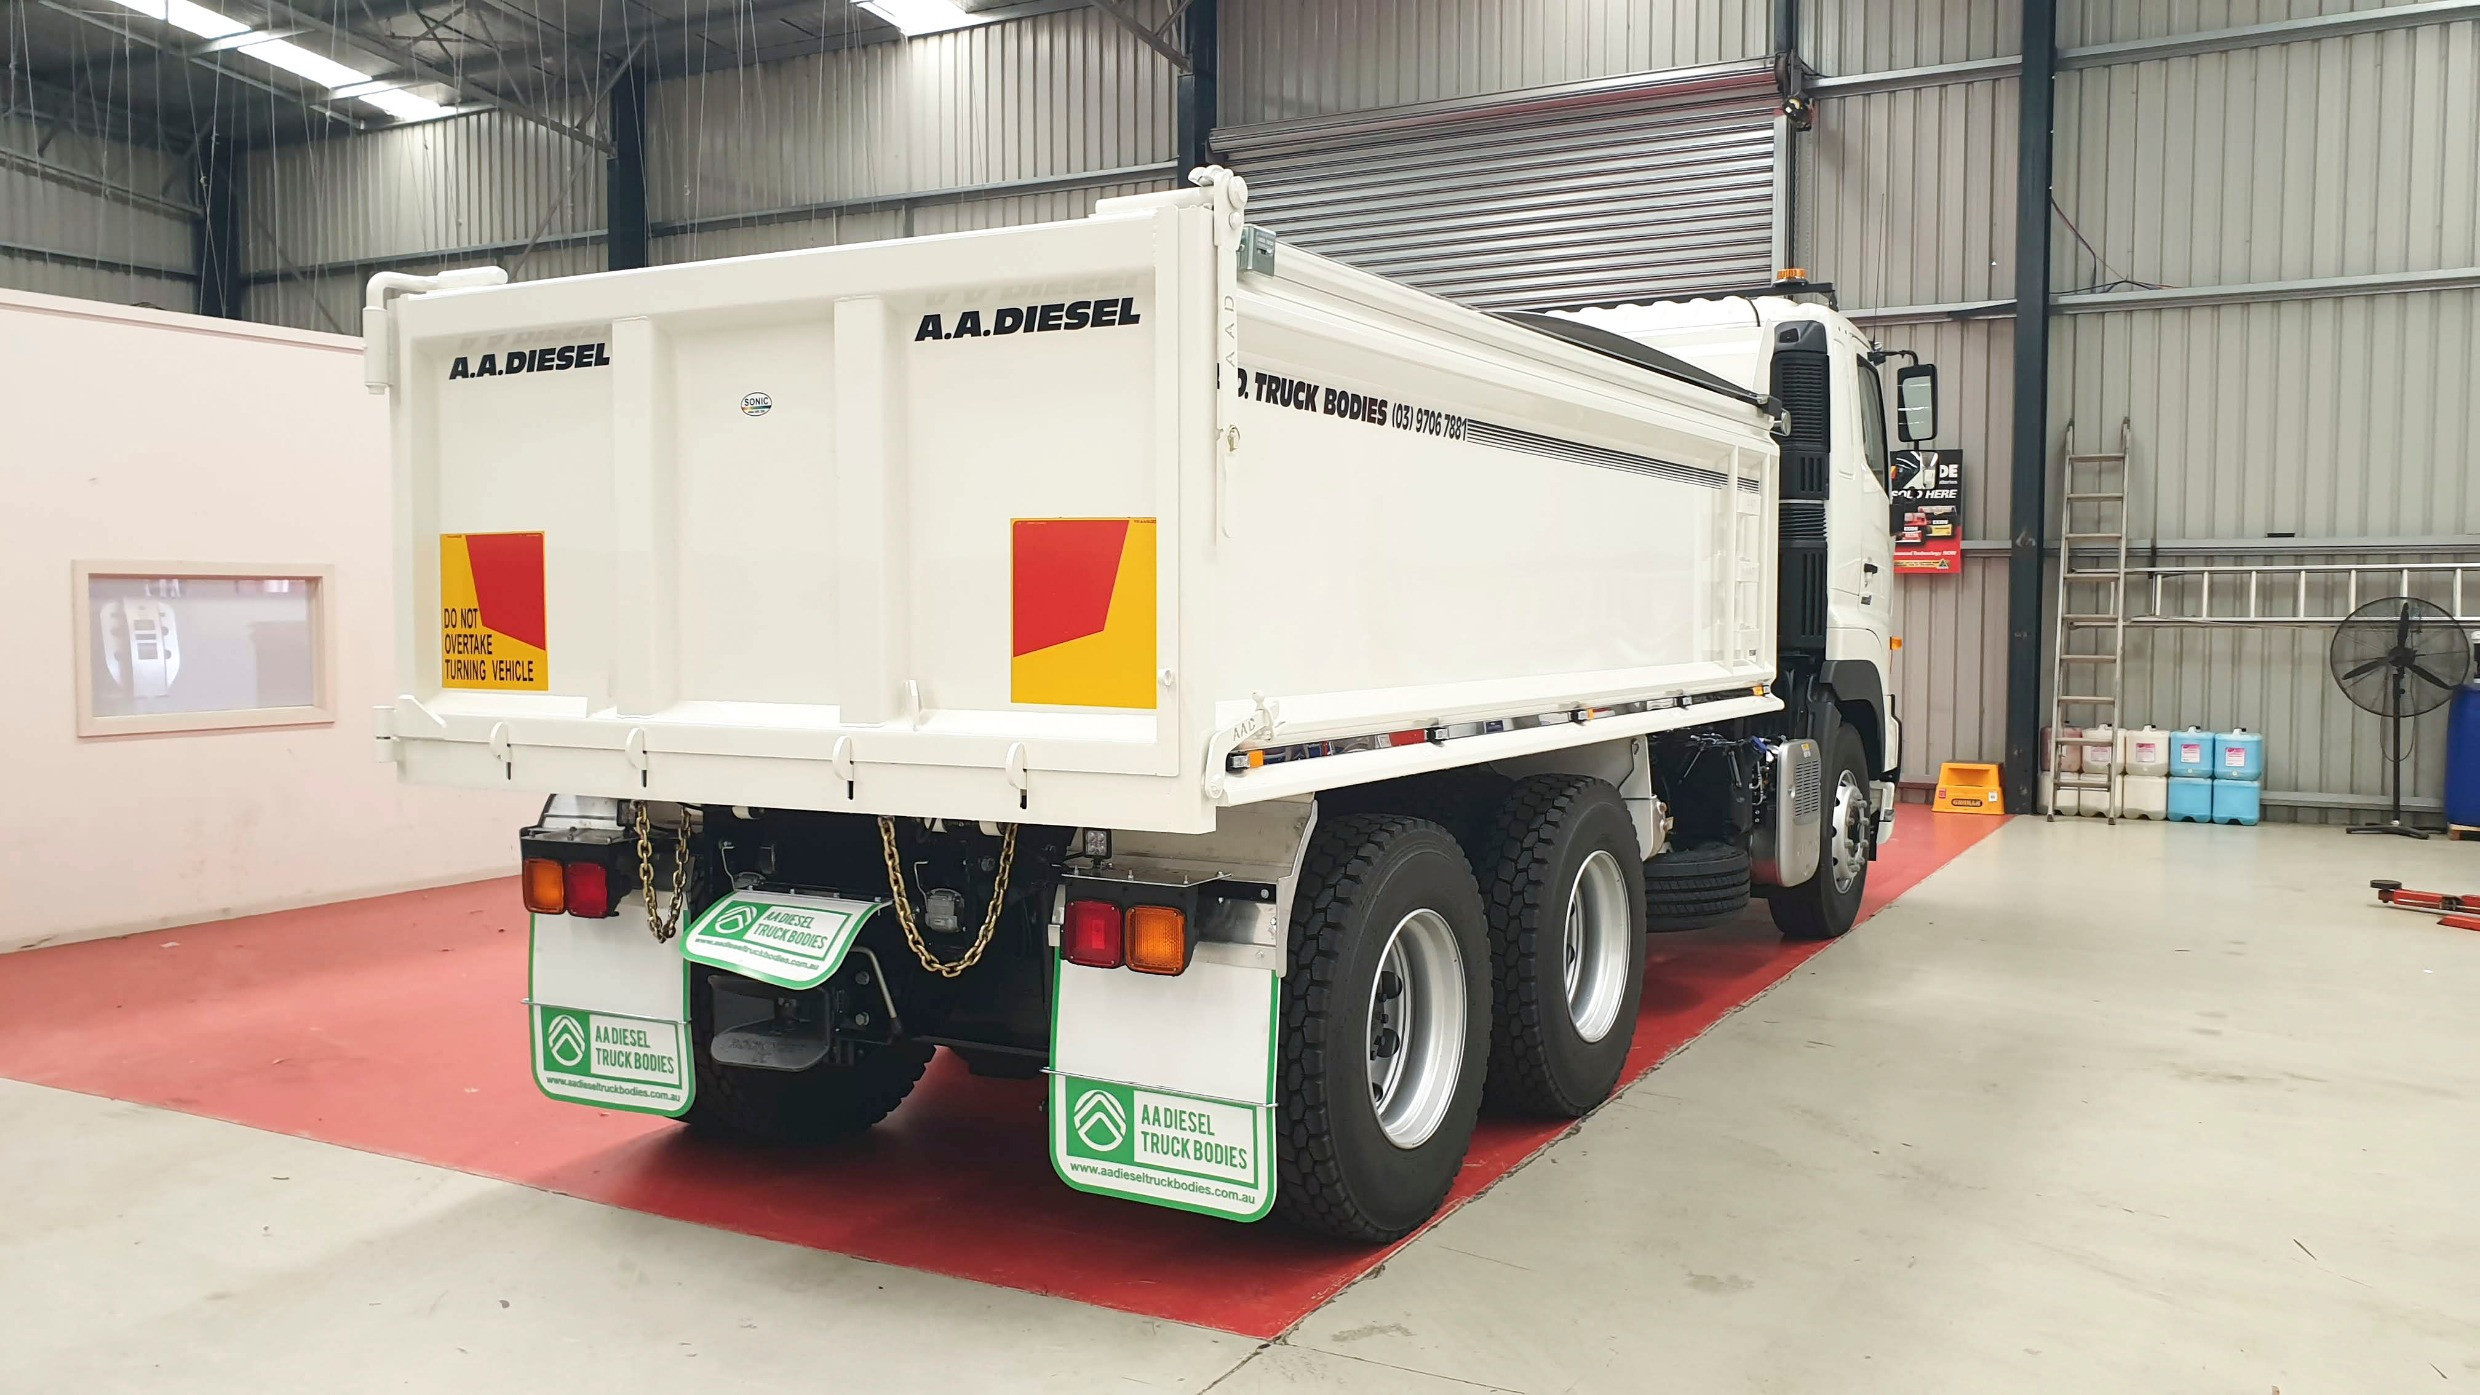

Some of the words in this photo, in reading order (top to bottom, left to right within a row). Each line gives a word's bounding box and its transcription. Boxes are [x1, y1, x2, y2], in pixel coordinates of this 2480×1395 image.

[915, 297, 1141, 341] A.A.DIESEL
[449, 343, 611, 380] A.A.DIESEL
[744, 397, 769, 406] SONIC
[1255, 372, 1320, 412] TRUCK
[1323, 388, 1388, 426] BODIES
[1392, 402, 1414, 431] (03)
[1415, 408, 1442, 437] 9706
[1442, 414, 1468, 441] 7881
[1925, 489, 1958, 499] HERE
[444, 608, 457, 629] DO
[460, 608, 478, 629] NOT
[444, 634, 493, 655] OVERTAKE
[445, 659, 486, 681] TURNING
[492, 660, 534, 682] VEHICLE
[779, 913, 815, 930] DIESEL
[753, 923, 788, 941] TRUCK
[787, 931, 829, 950] BODIES
[695, 938, 820, 970] www.aadieseltruckbodies.com.au
[612, 1028, 651, 1048] DIESEL
[596, 1048, 633, 1070] TRUCK
[634, 1051, 675, 1074] BODIES
[546, 1076, 681, 1102] www.aadieseltruckbodies.com.au
[1164, 1108, 1216, 1136] DIESEL
[1141, 1131, 1191, 1160] TRUCK
[1194, 1139, 1248, 1170] BODIES
[1069, 1162, 1256, 1204] www.aadieseltruckbodies.com.au
